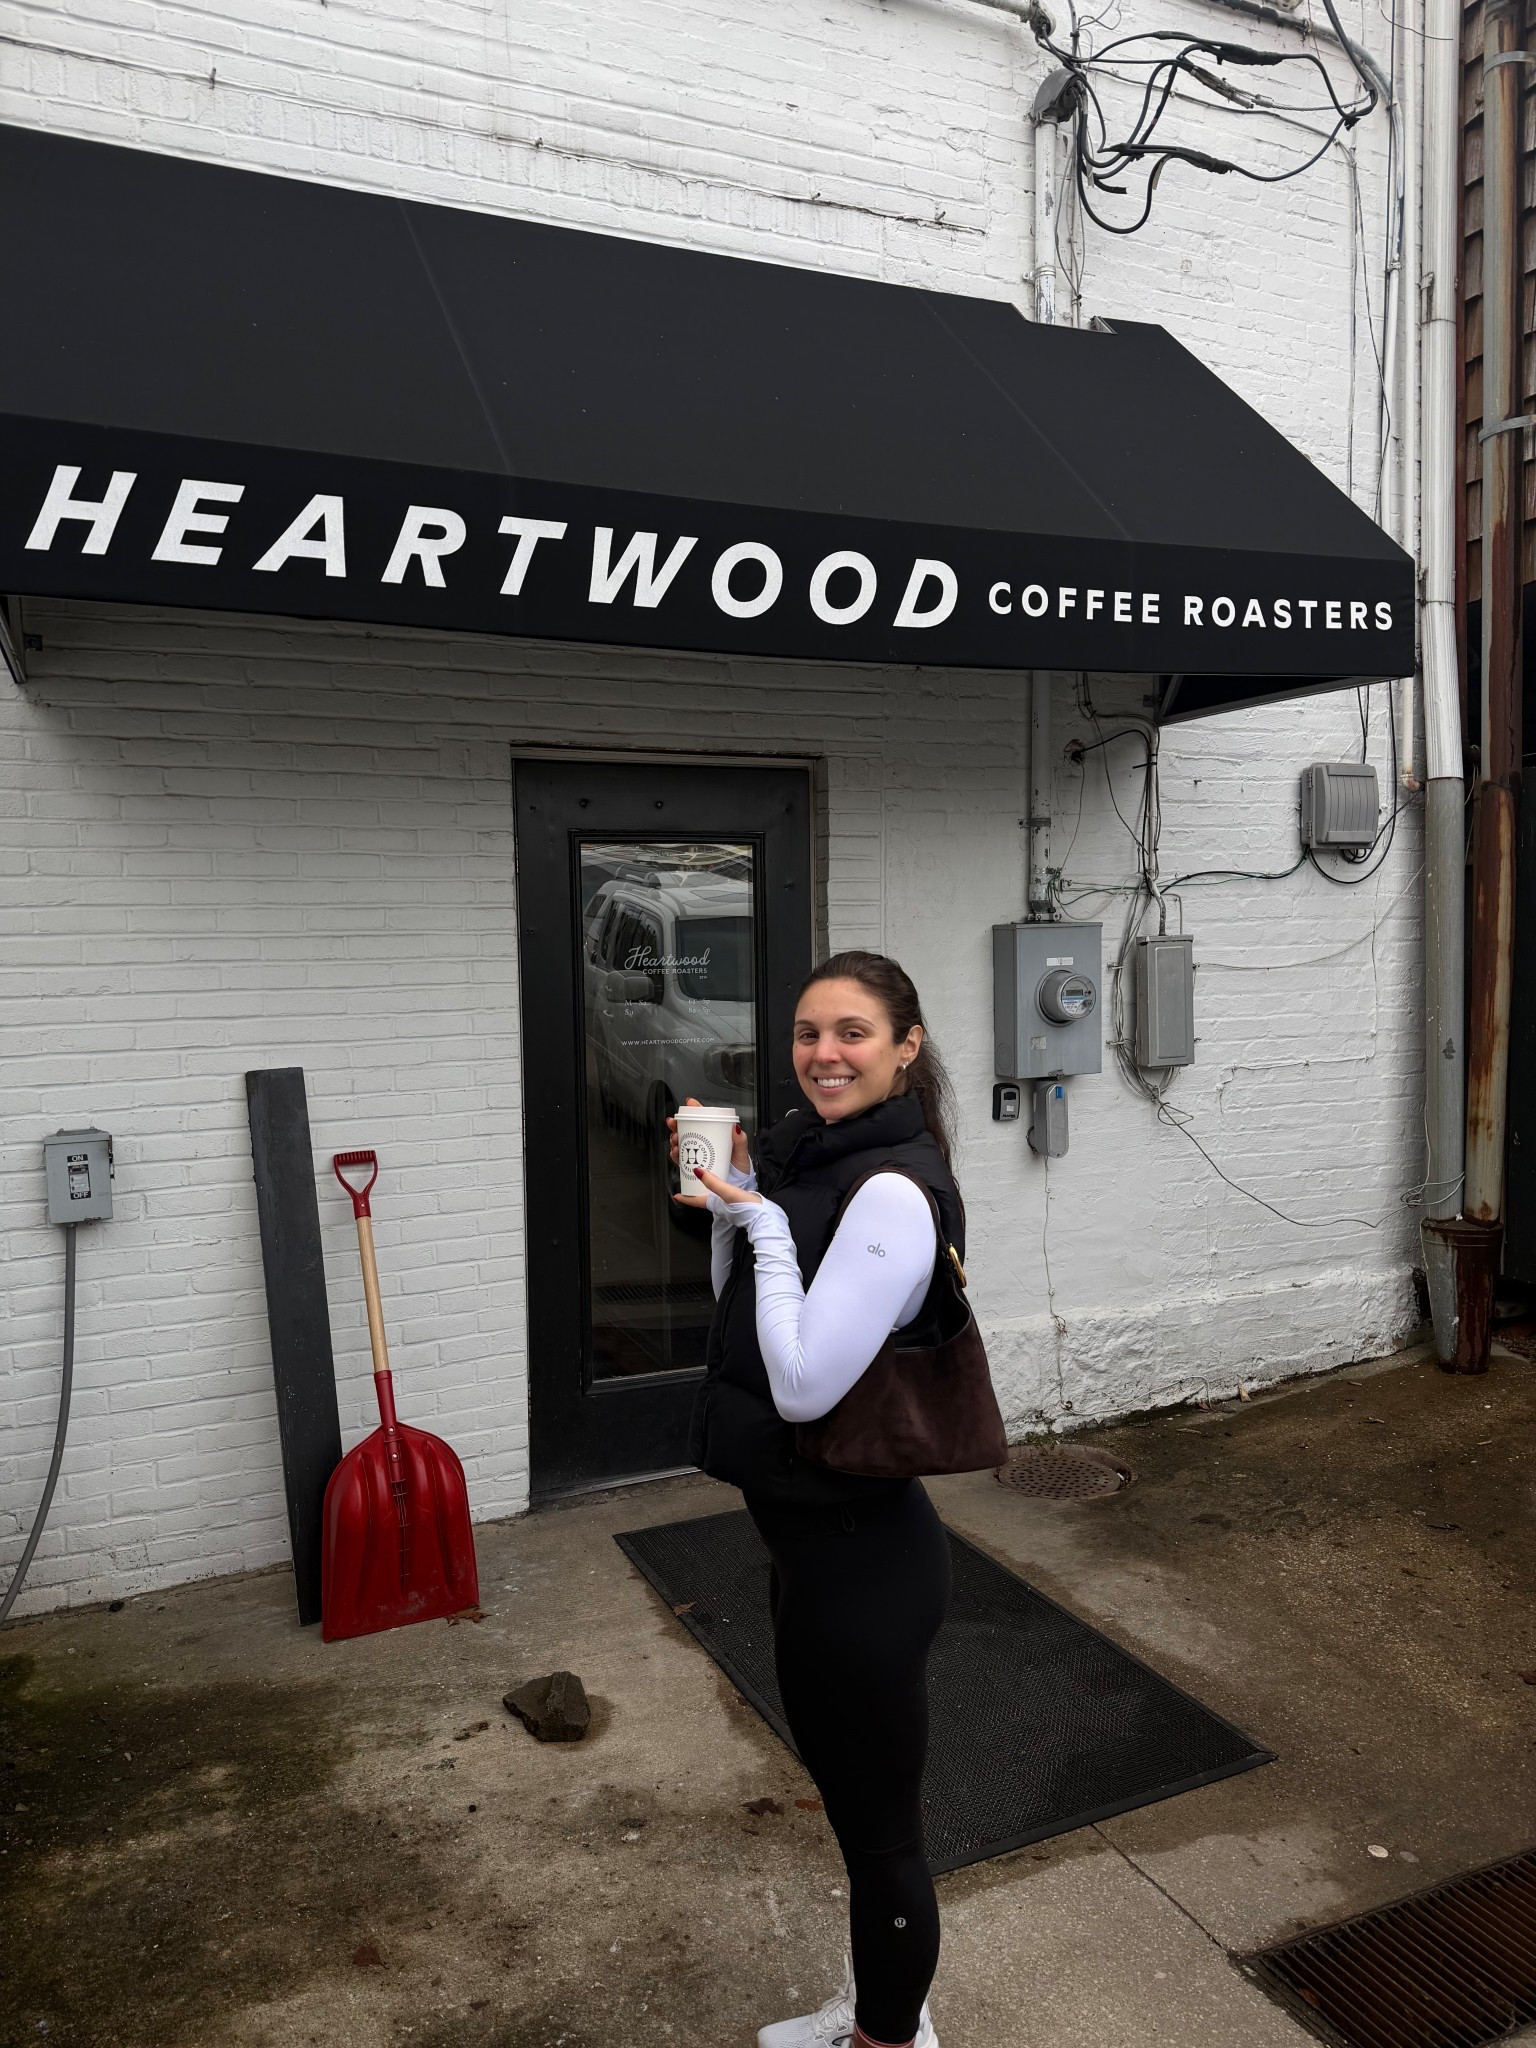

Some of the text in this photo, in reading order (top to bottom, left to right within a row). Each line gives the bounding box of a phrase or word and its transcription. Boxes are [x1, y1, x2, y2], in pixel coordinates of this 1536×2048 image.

[25, 465, 1394, 632] HEARTWOOD COFFEE ROASTERS
[624, 946, 710, 970] Heartwood
[621, 1038, 715, 1046] WWW.HEARTWOODCOFFEE.COM
[686, 1148, 699, 1164] H
[867, 1243, 886, 1258] alo
